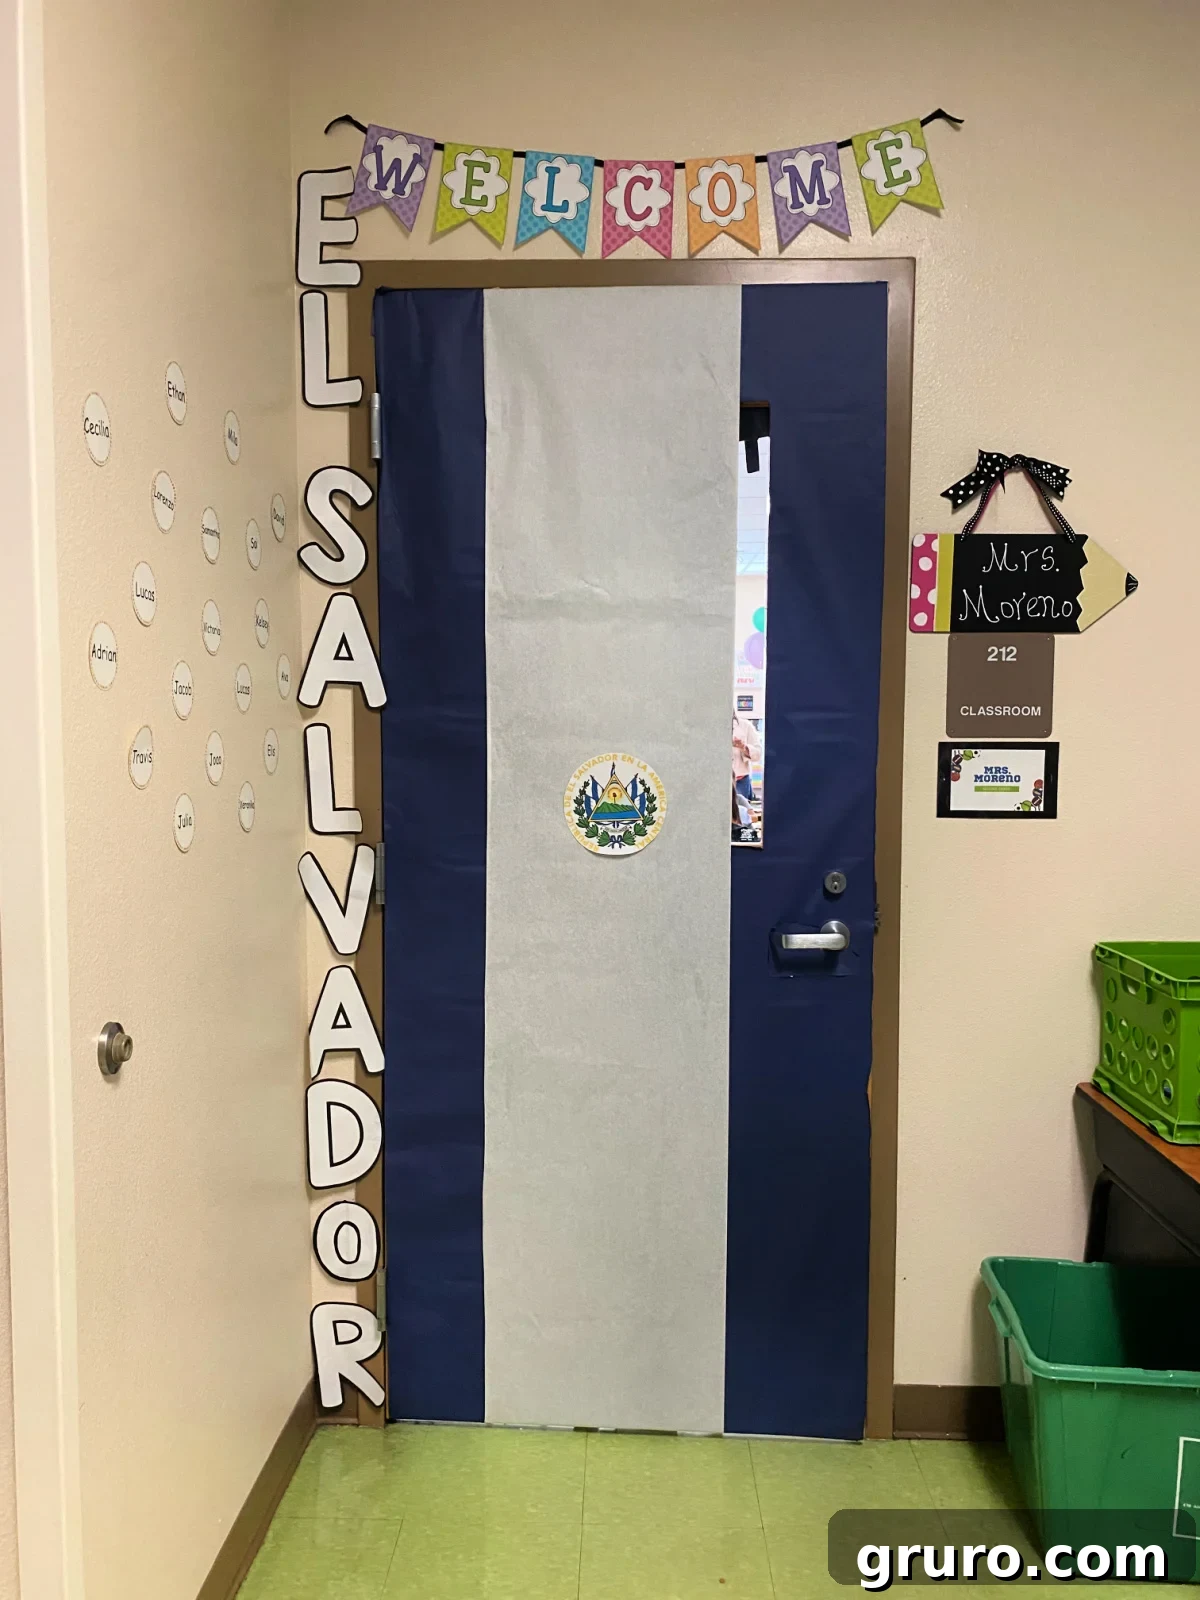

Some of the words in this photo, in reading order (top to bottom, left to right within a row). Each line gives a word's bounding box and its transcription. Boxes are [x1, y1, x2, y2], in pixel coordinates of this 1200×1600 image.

[372, 138, 912, 222] WELCOME
[295, 166, 364, 408] EL
[167, 380, 186, 403] Ethan
[83, 417, 110, 438] Cecilia
[153, 486, 175, 511] Lorenzo
[982, 542, 1060, 572] Mrs.
[135, 582, 155, 602] Lucas
[958, 585, 1074, 623] Moreno
[91, 643, 117, 663] Adrian
[987, 646, 1018, 662] 212
[173, 680, 193, 697] Jacob
[960, 705, 1042, 717] CLASSROOM
[132, 749, 153, 764] Travis
[983, 766, 1012, 775] MRS.
[574, 754, 618, 780] SALVADOR
[621, 755, 634, 764] EN
[637, 761, 648, 772] LA
[647, 772, 667, 813] AMERICA
[177, 814, 193, 829] Julia
[297, 465, 388, 1408] SALVADOR
